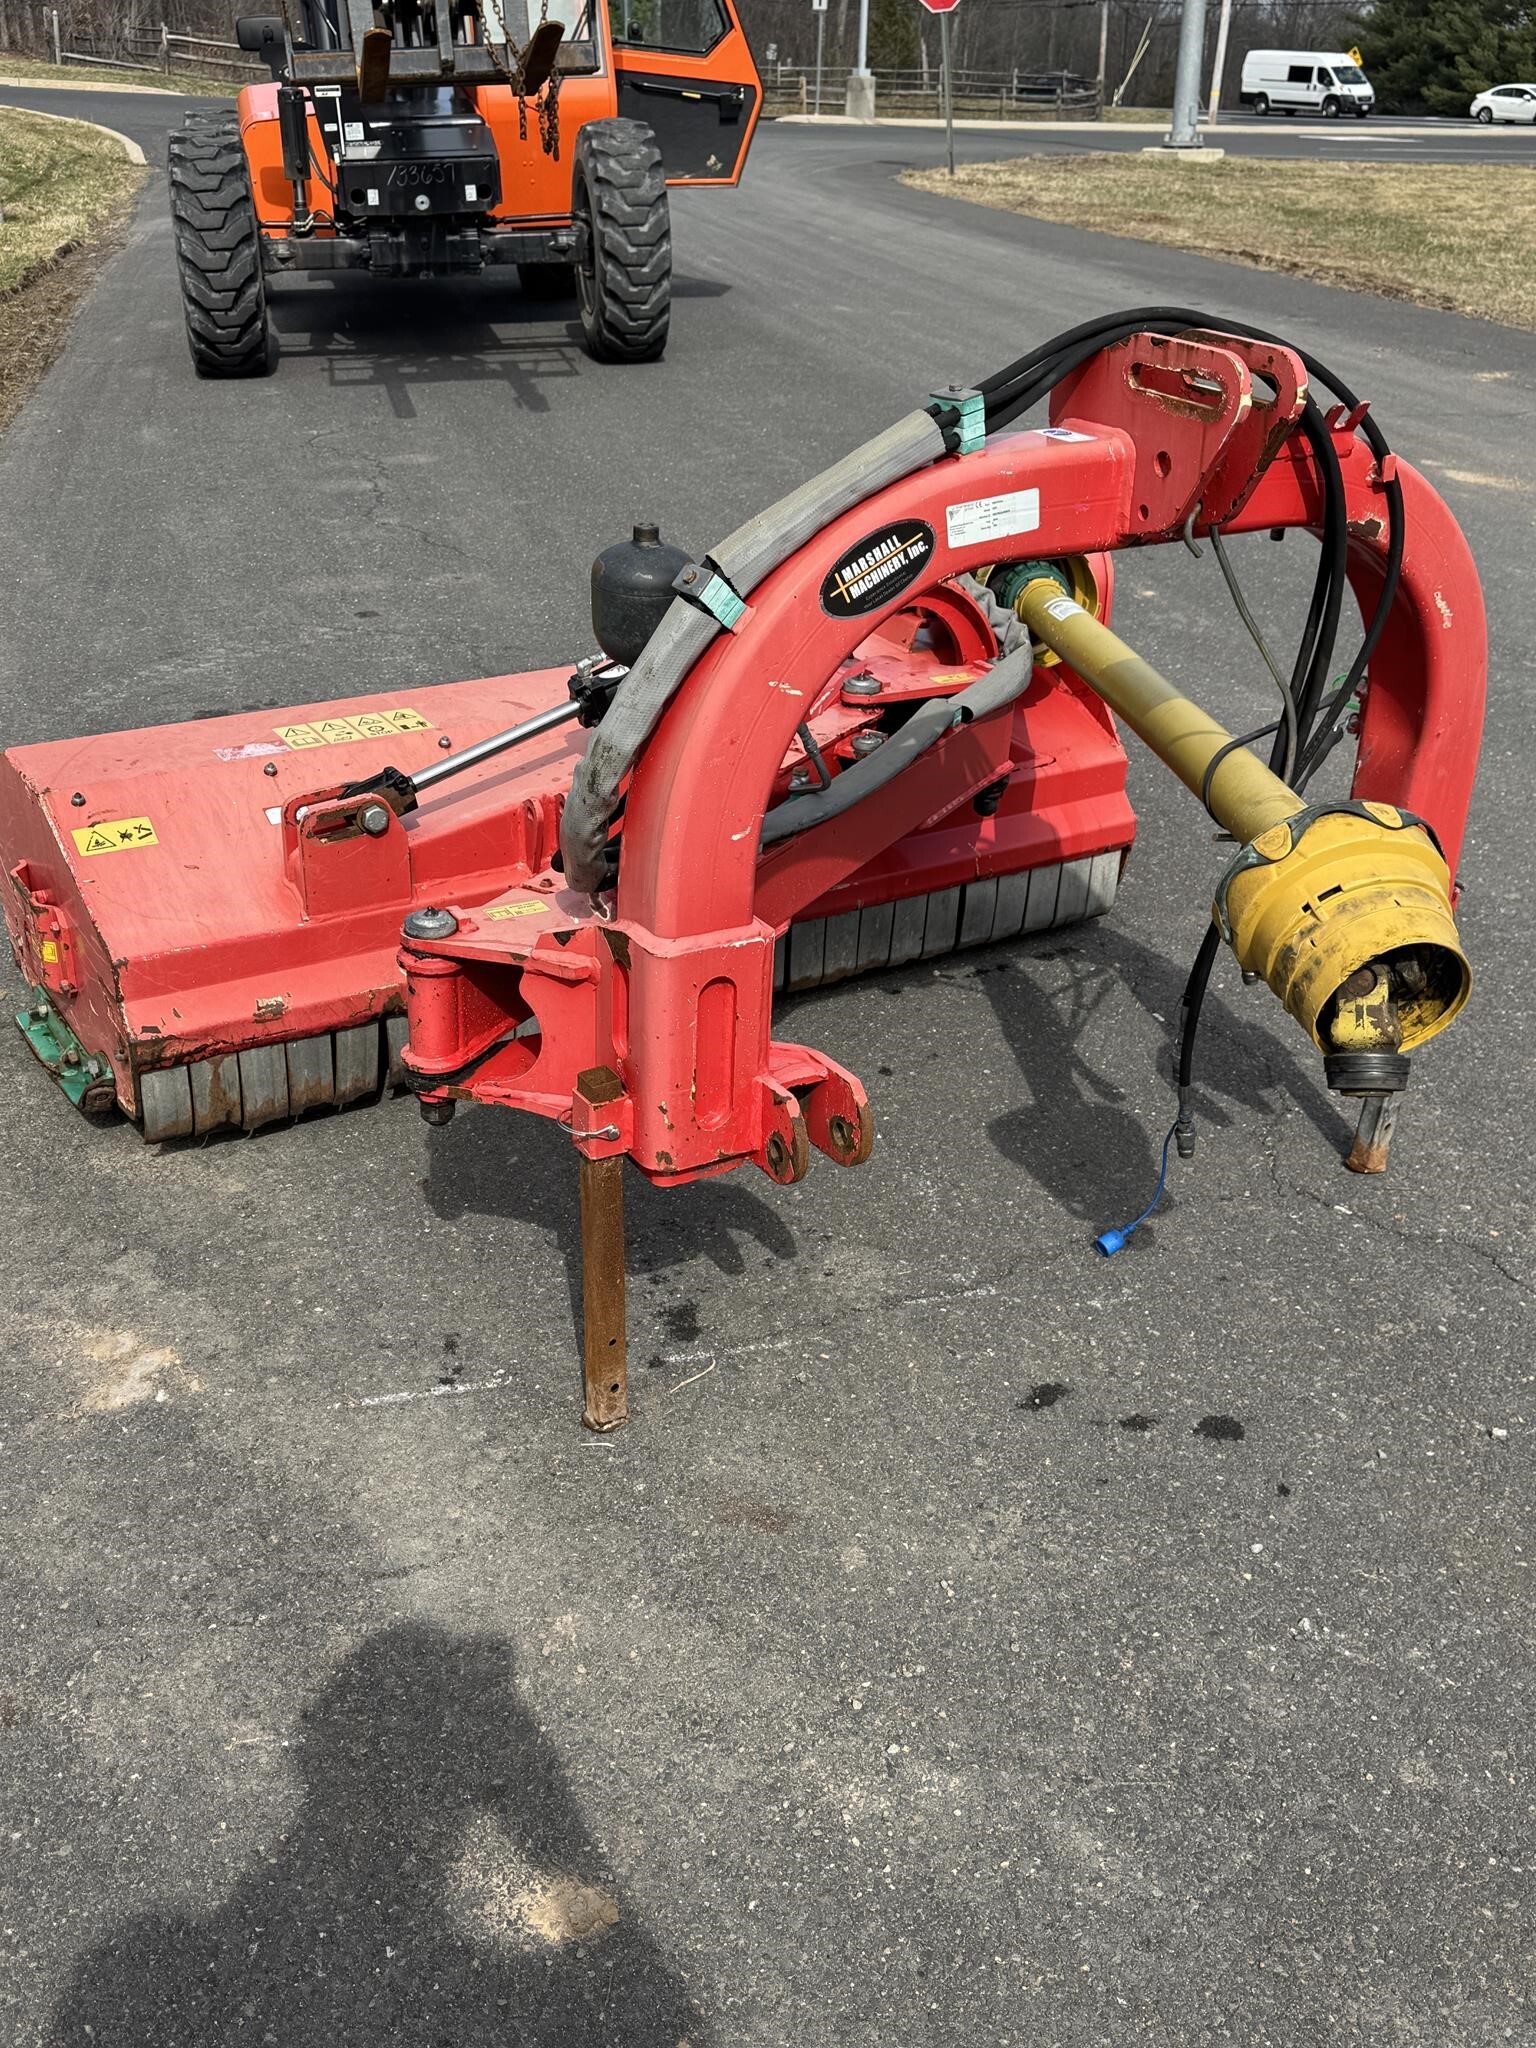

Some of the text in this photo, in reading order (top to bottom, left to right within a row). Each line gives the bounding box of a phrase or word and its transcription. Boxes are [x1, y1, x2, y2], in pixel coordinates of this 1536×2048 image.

[841, 534, 902, 583] MARSHALL
[848, 551, 909, 600] MACHINERY,
[906, 541, 929, 560] Inc.
